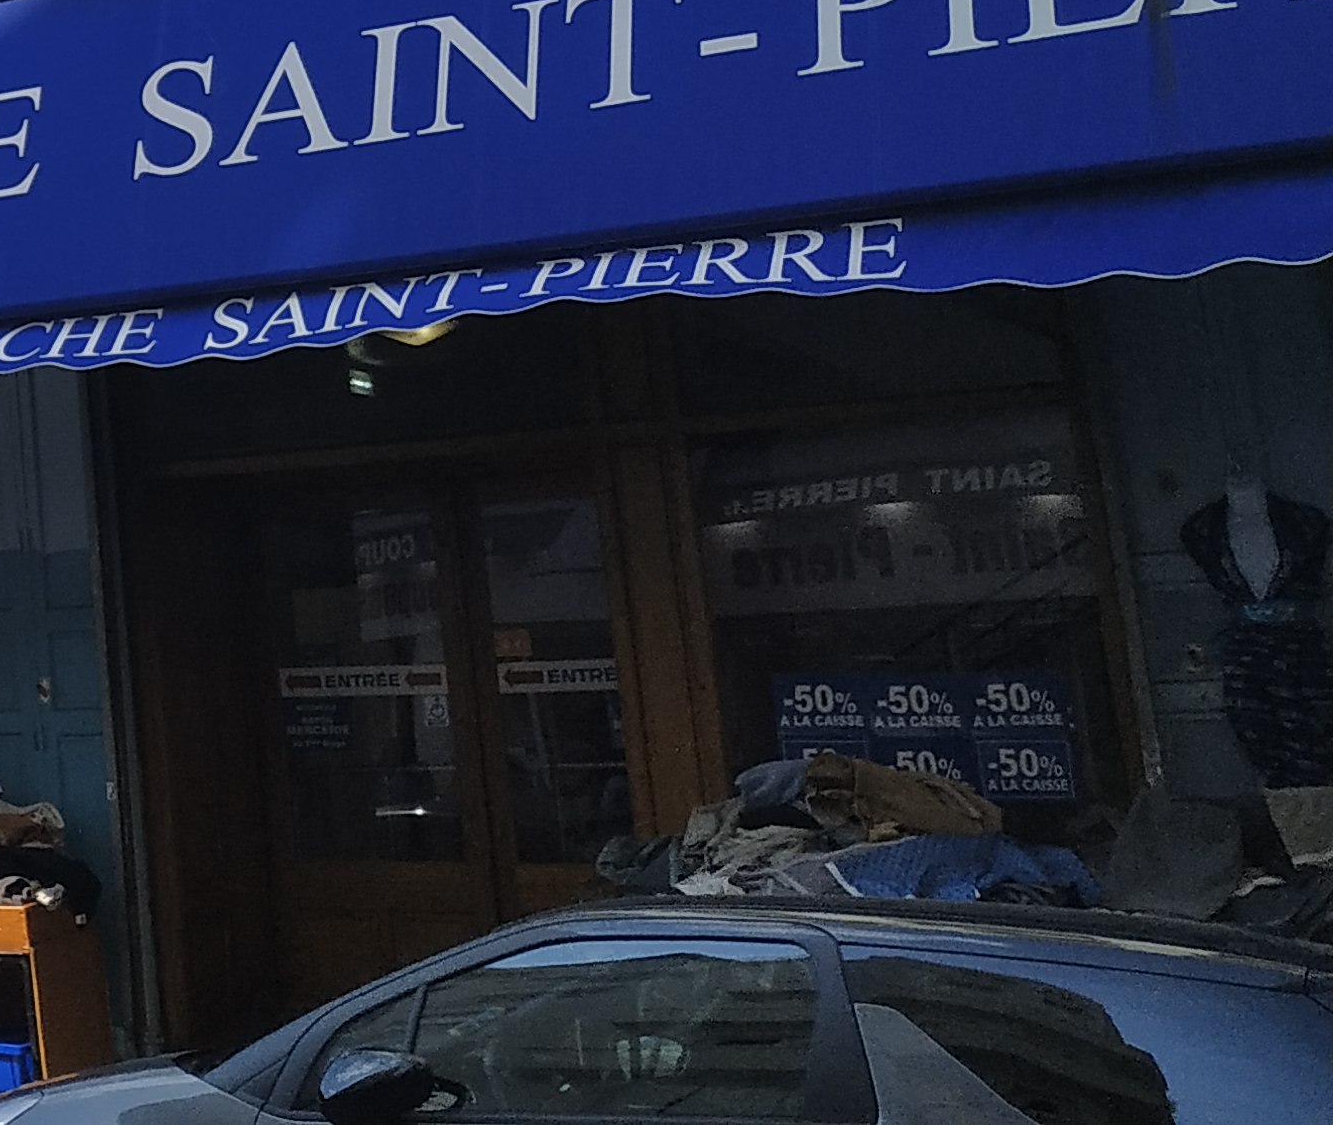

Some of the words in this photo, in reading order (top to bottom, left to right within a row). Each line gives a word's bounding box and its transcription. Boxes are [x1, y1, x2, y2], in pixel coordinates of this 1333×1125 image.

[325, 672, 400, 688] ENTRÉE
[783, 683, 857, 714] -50%
[876, 684, 953, 714] -50%
[975, 682, 1056, 713] -50%
[781, 716, 790, 727] A
[793, 716, 811, 727] LA
[815, 715, 864, 728] CAISSE
[874, 717, 885, 728] A
[889, 716, 907, 727] LA
[910, 715, 961, 728] CAISSE
[973, 716, 985, 728] A
[988, 715, 1006, 727] LA
[1010, 714, 1064, 726] CAISSE
[988, 748, 1064, 778] -50%
[988, 780, 997, 791] A
[1000, 779, 1019, 790] LA
[1023, 779, 1069, 791] CAISSE
